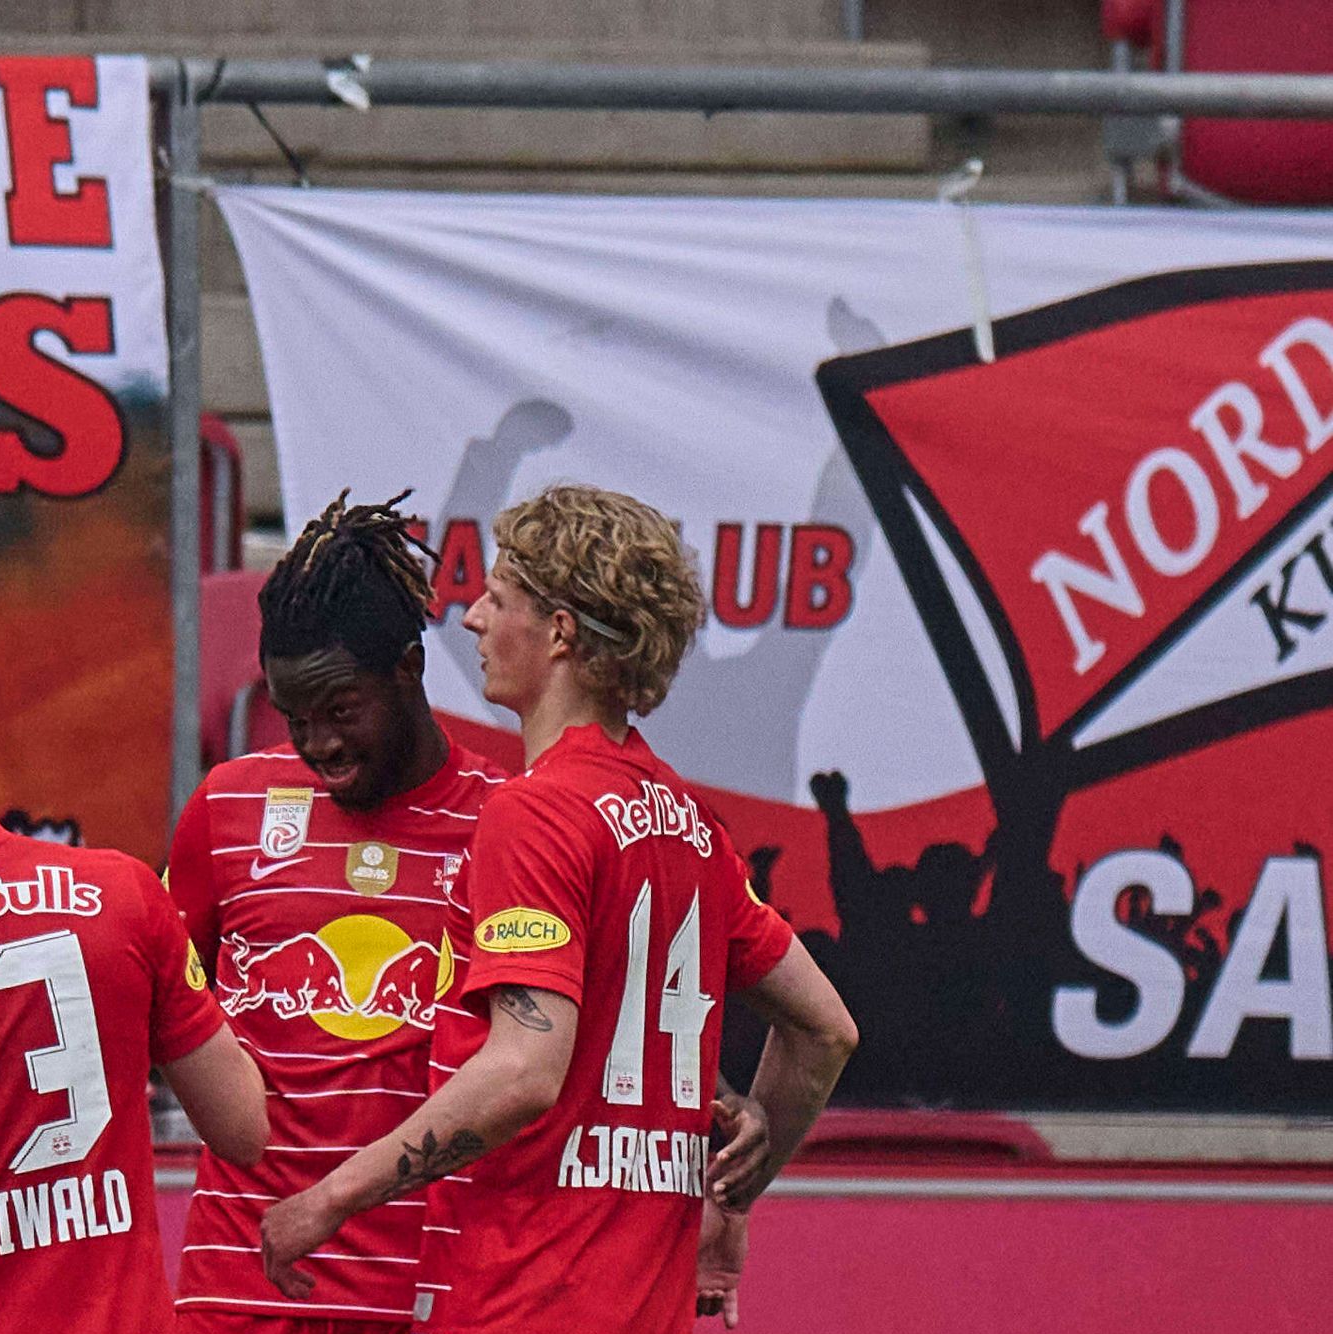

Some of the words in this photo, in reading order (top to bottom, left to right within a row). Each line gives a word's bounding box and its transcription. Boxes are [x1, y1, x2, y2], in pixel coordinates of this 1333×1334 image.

[1030, 315, 1333, 676] NORD
[497, 921, 557, 940] RAUCH
[602, 878, 715, 1109] 14
[1052, 848, 1333, 1061] SA
